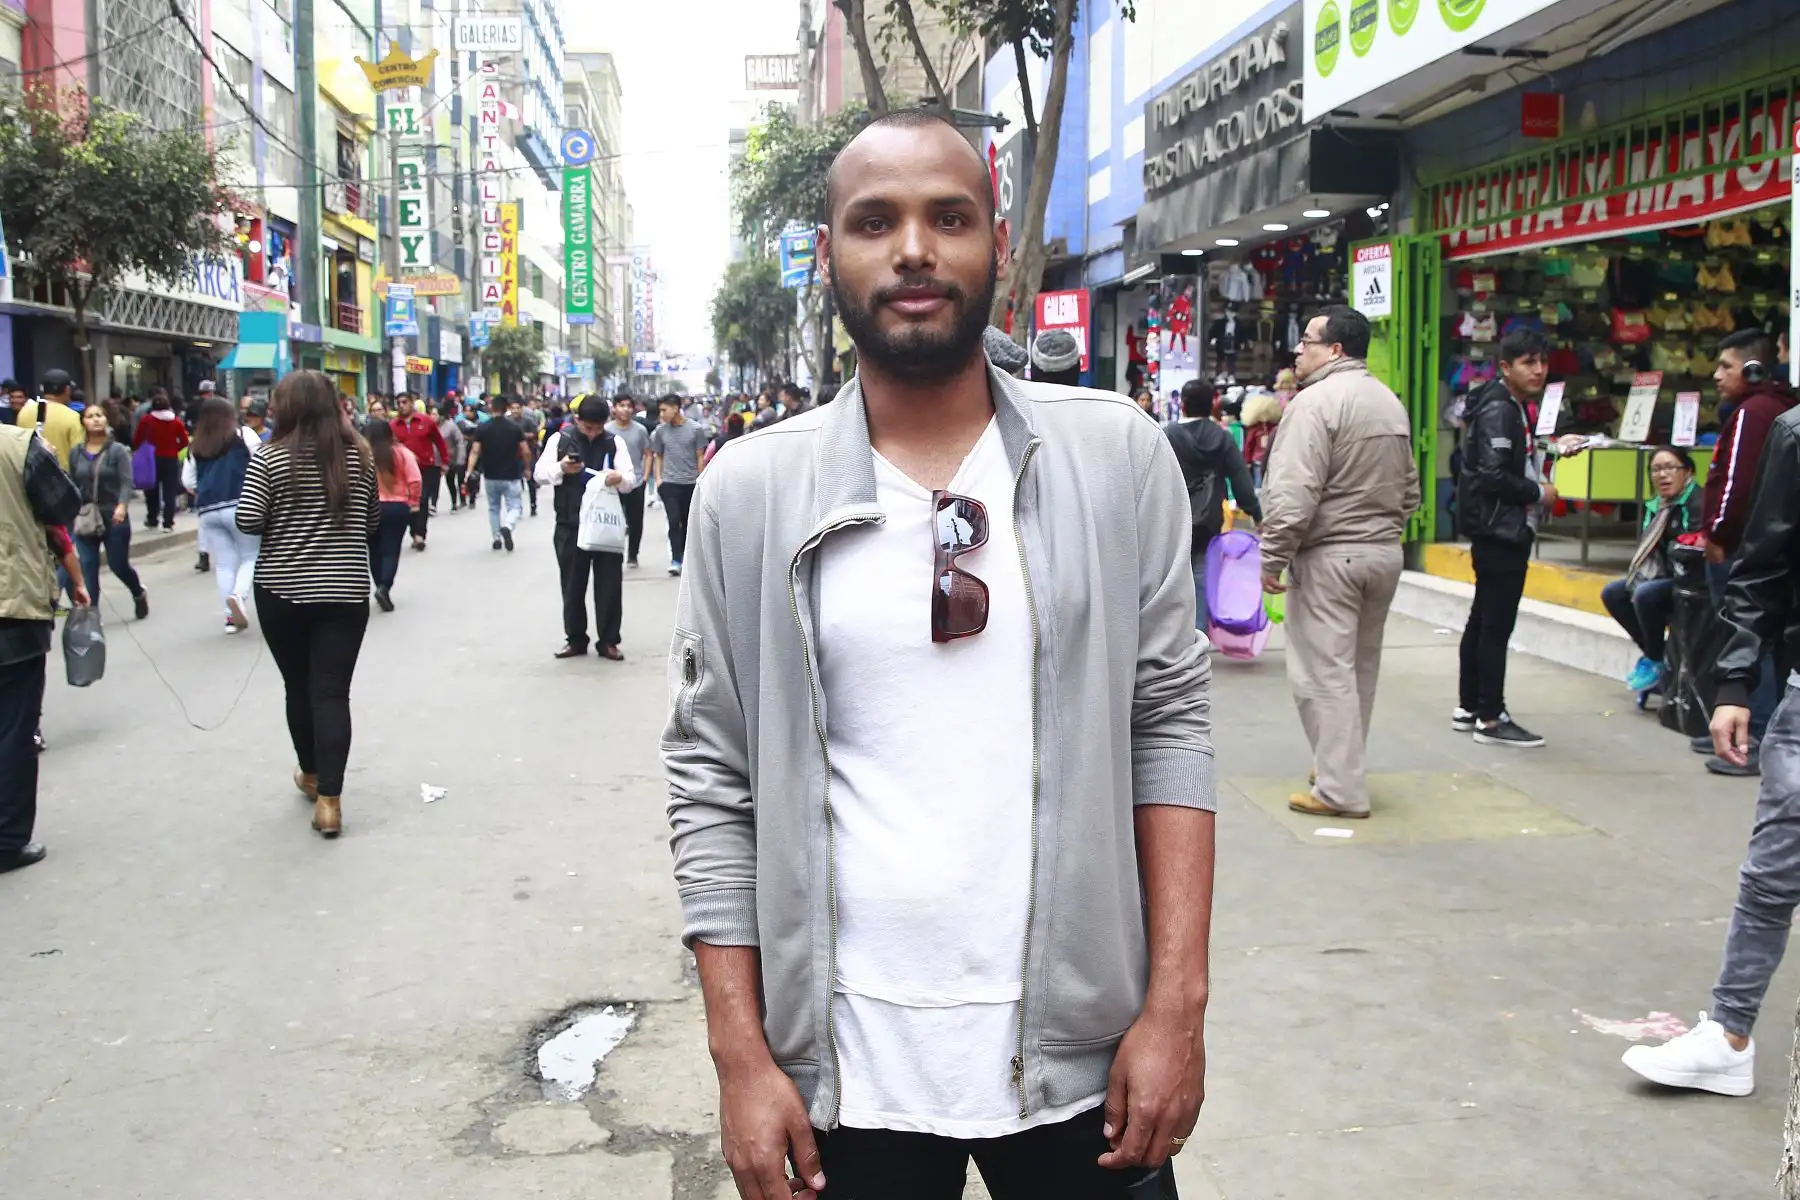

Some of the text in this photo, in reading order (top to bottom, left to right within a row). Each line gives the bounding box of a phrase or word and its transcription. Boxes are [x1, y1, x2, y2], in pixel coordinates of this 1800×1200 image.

[460, 24, 517, 44] GALERIAS
[387, 107, 420, 135] EL
[398, 163, 424, 264] REY
[1443, 166, 1564, 248] VENTA
[1577, 157, 1612, 226] X
[502, 217, 514, 317] CHIFA
[570, 174, 588, 308] CENTRO GAMARRA
[1356, 244, 1392, 263] OFERTA
[1043, 294, 1080, 325] GALERIA
